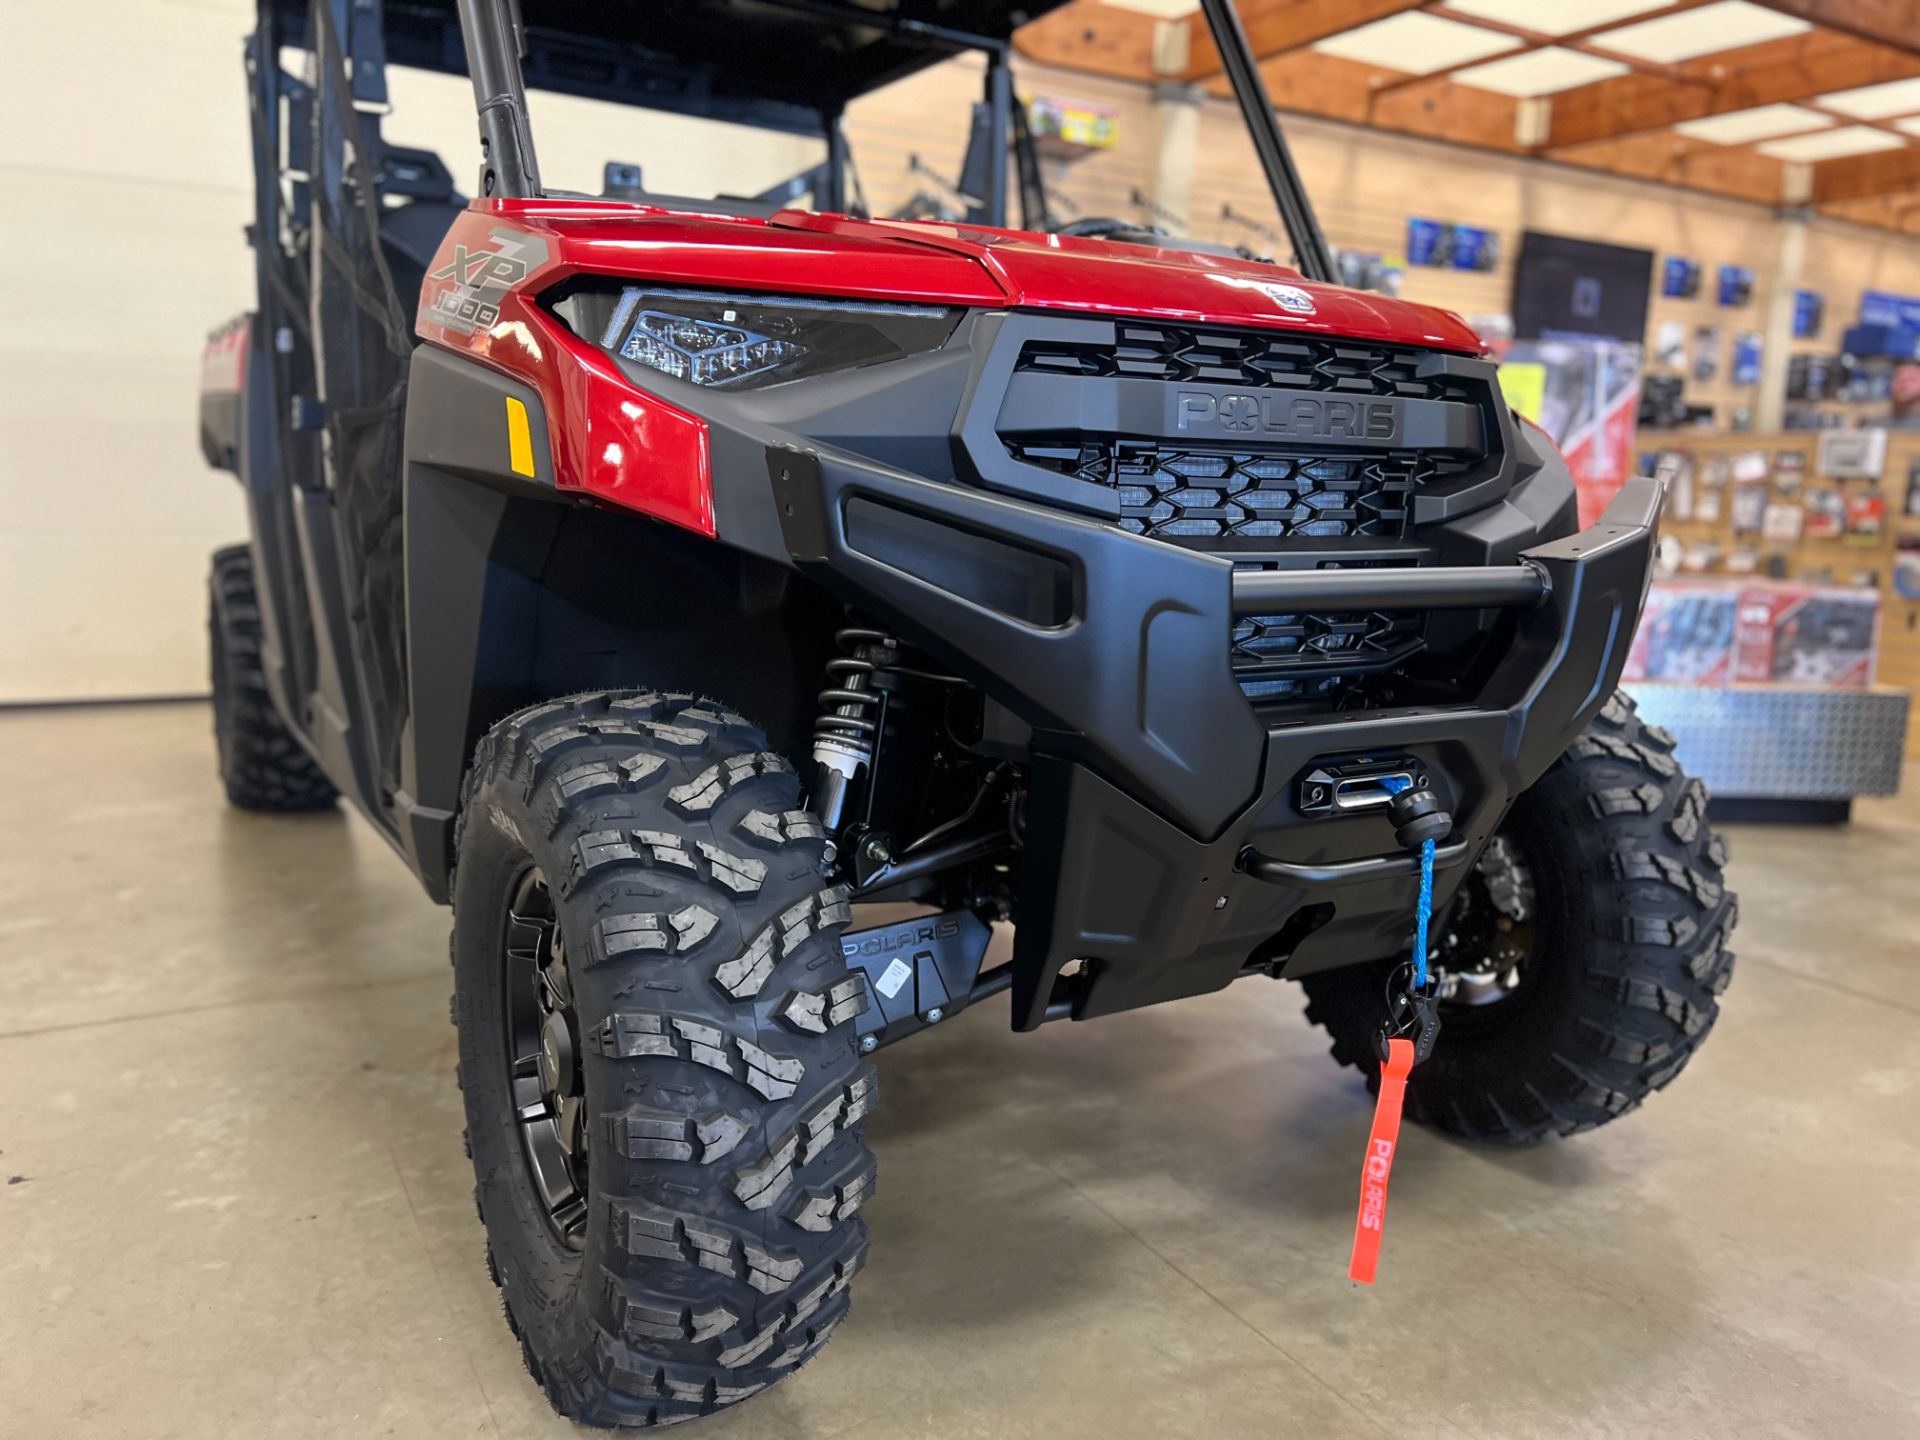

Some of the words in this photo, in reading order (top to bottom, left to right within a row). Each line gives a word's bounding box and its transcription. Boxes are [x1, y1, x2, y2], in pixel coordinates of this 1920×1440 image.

[430, 244, 527, 290] XP
[432, 289, 500, 329] 1000
[1177, 390, 1395, 440] POLARIS
[1361, 1137, 1392, 1232] POLARIS
